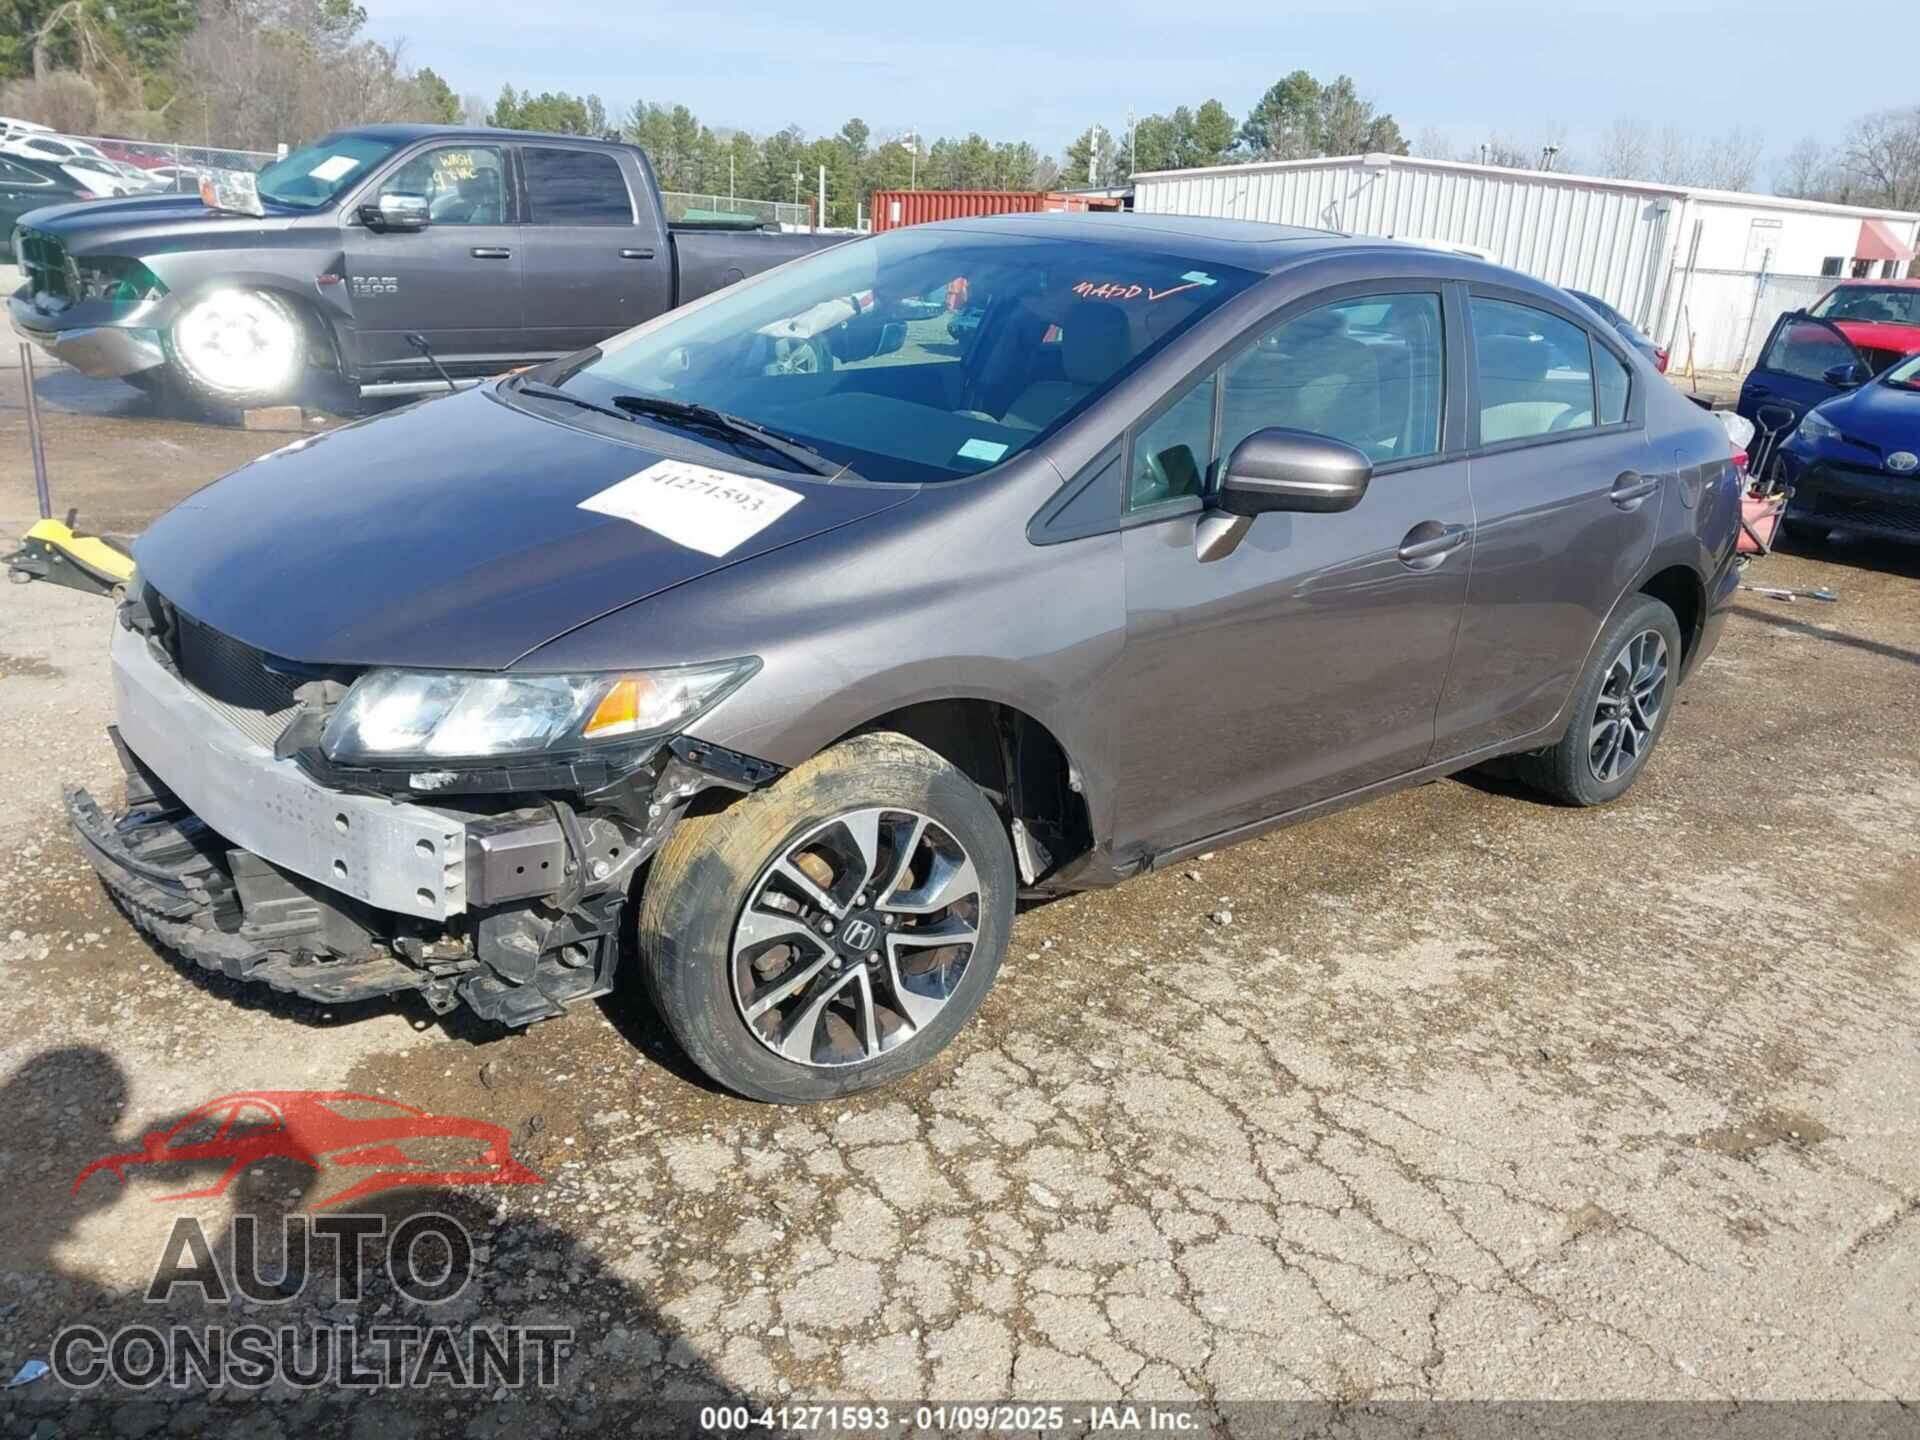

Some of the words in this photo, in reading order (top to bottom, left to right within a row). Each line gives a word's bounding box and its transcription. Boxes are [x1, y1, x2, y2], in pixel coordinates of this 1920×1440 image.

[353, 276, 398, 285] RAM
[353, 285, 398, 293] 1500
[651, 473, 764, 511] 41271593
